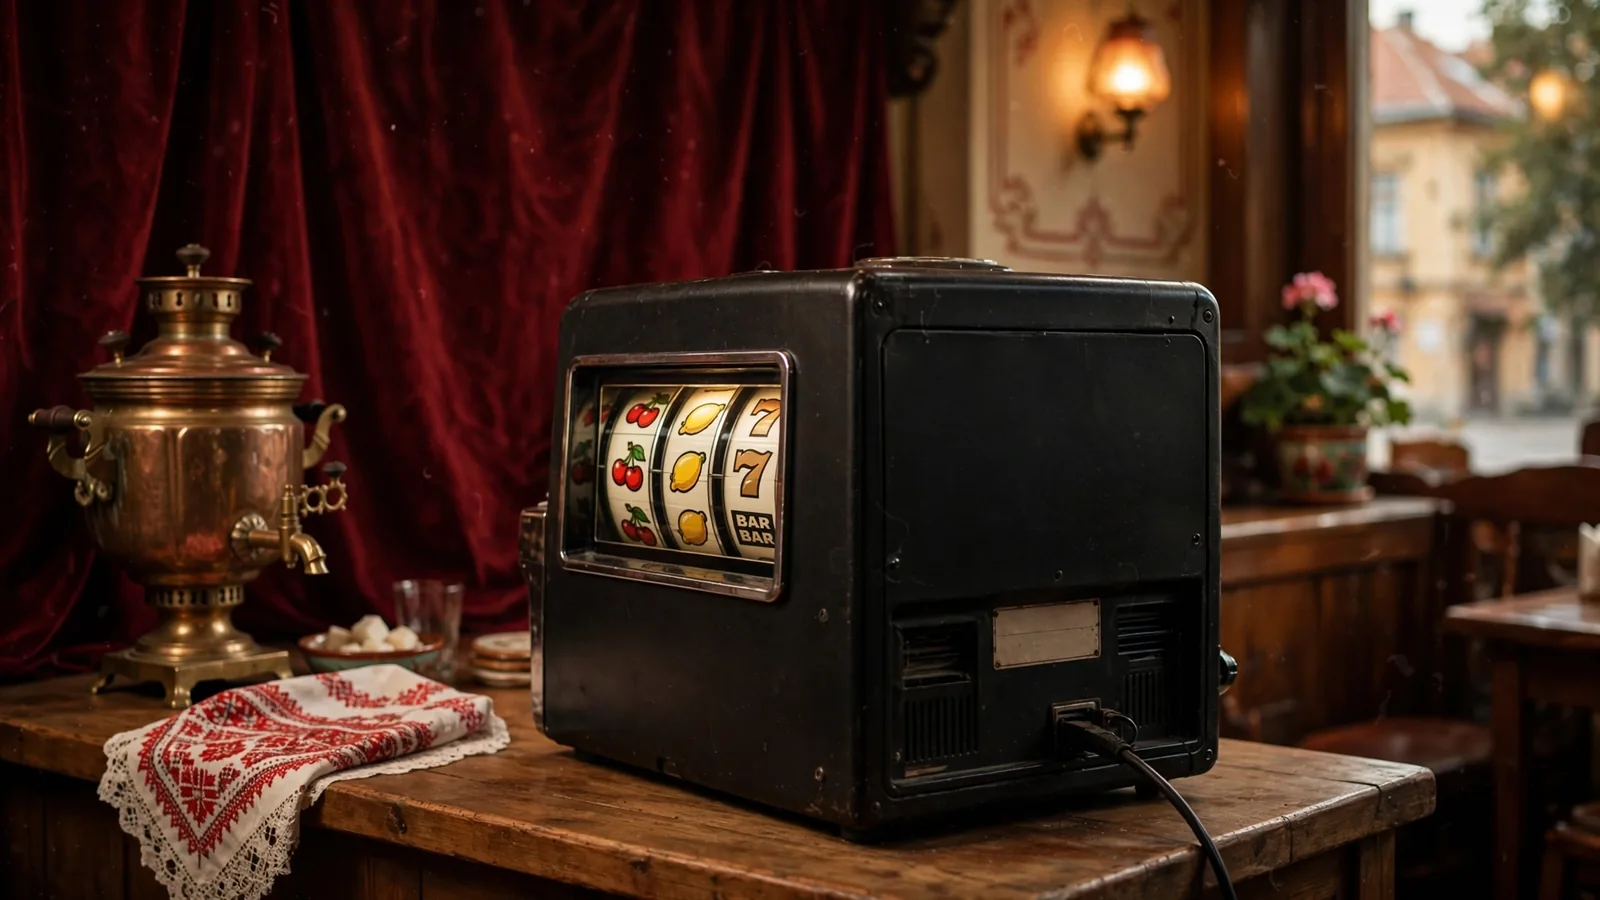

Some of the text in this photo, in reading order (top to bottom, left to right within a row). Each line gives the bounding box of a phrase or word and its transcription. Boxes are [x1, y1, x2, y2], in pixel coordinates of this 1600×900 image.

[750, 399, 781, 437] 7
[733, 449, 773, 498] 7
[736, 514, 771, 530] BAR
[739, 529, 775, 544] BAR
